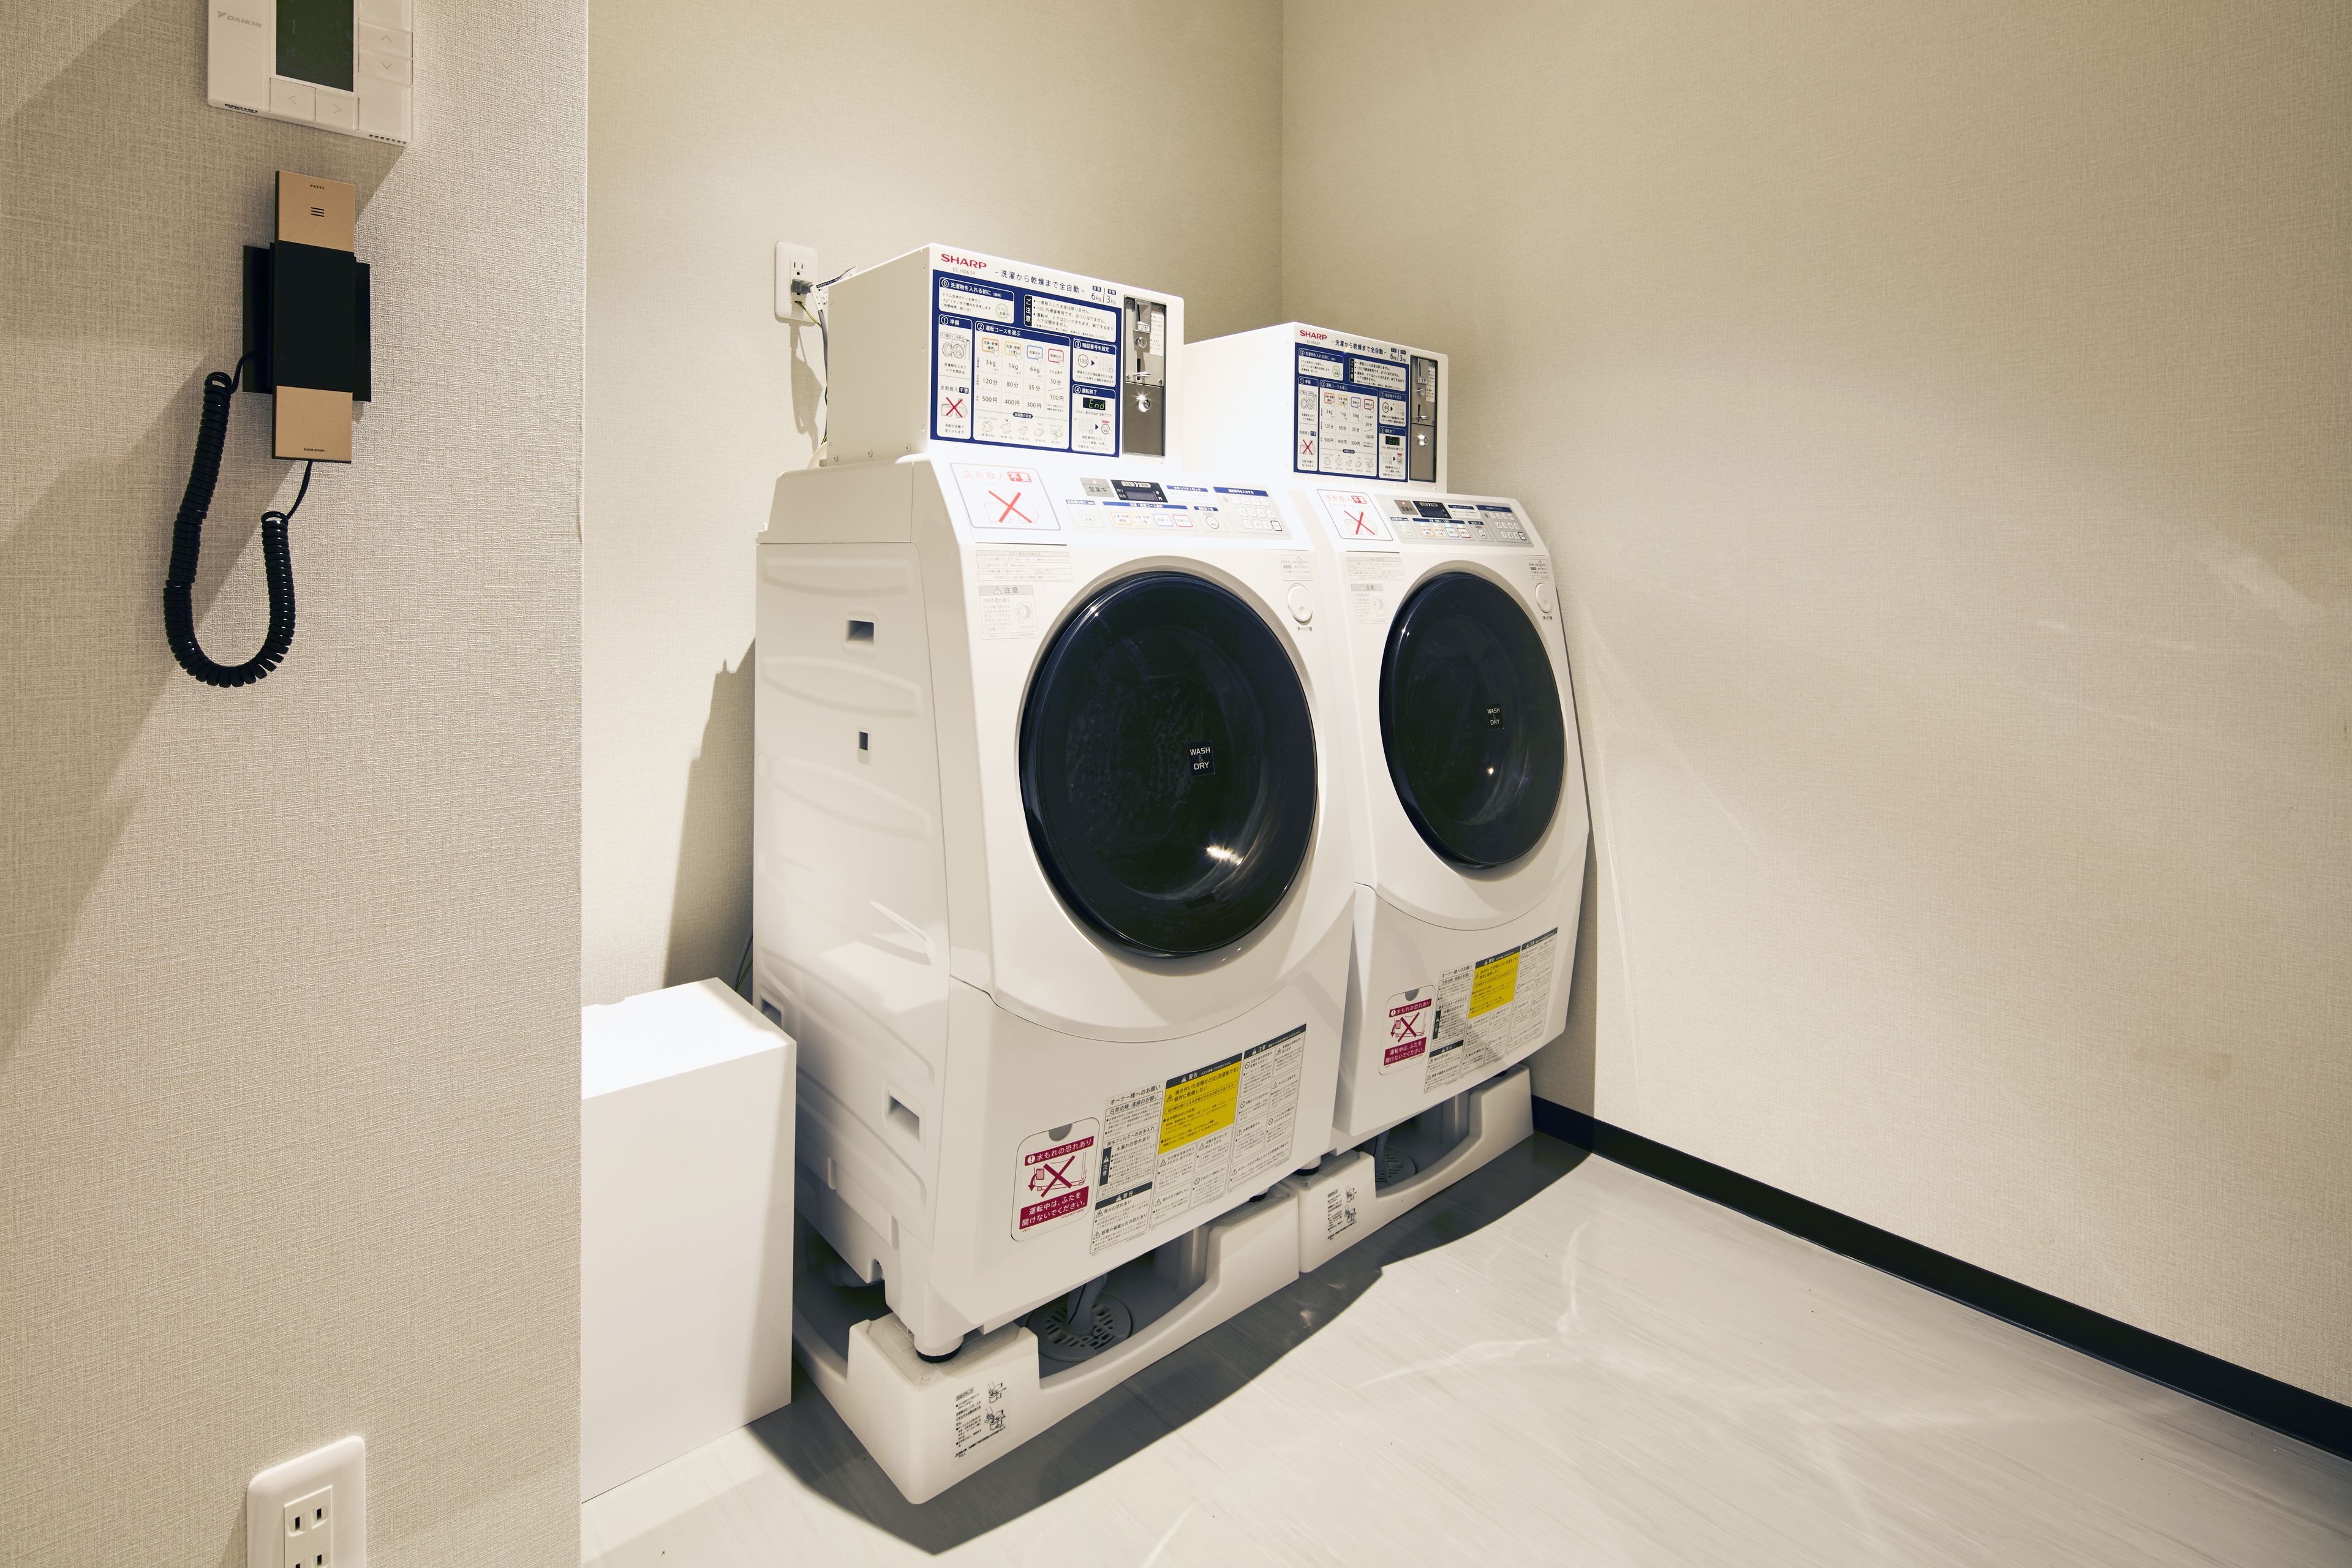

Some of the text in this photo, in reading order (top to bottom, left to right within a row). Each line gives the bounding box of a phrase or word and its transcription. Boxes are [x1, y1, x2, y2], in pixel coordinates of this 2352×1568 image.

[227, 15, 262, 28] DAIKIN
[941, 254, 987, 269] SHARP
[952, 267, 975, 276] ES-HD63P
[950, 282, 992, 295] 洗濯物を入れる前に
[1091, 293, 1116, 304] 6kg 3kg
[985, 325, 1021, 336] 運転コースを選ぶ
[1300, 330, 1327, 340] SHARP
[1088, 399, 1105, 410] End
[1189, 747, 1210, 756] WASH
[1194, 761, 1209, 770] DRY
[1396, 1001, 1430, 1015] 水もれの恐れあり
[1390, 1041, 1422, 1055] 運転中は、ふたを
[1385, 1048, 1424, 1063] 開けないでください。
[1110, 1085, 1161, 1105] オーナー様へのお願い
[1174, 1086, 1208, 1102] 絶対に乾燥しない
[1110, 1095, 1159, 1114] 日常点検・清掃のお願い
[1107, 1126, 1155, 1146] 排水フィルターのお手入れ
[1036, 1139, 1091, 1161] 水もれの恐れあり
[1029, 1192, 1081, 1215] 運転中は、ふたを
[1022, 1200, 1086, 1226] 開けないでください。
